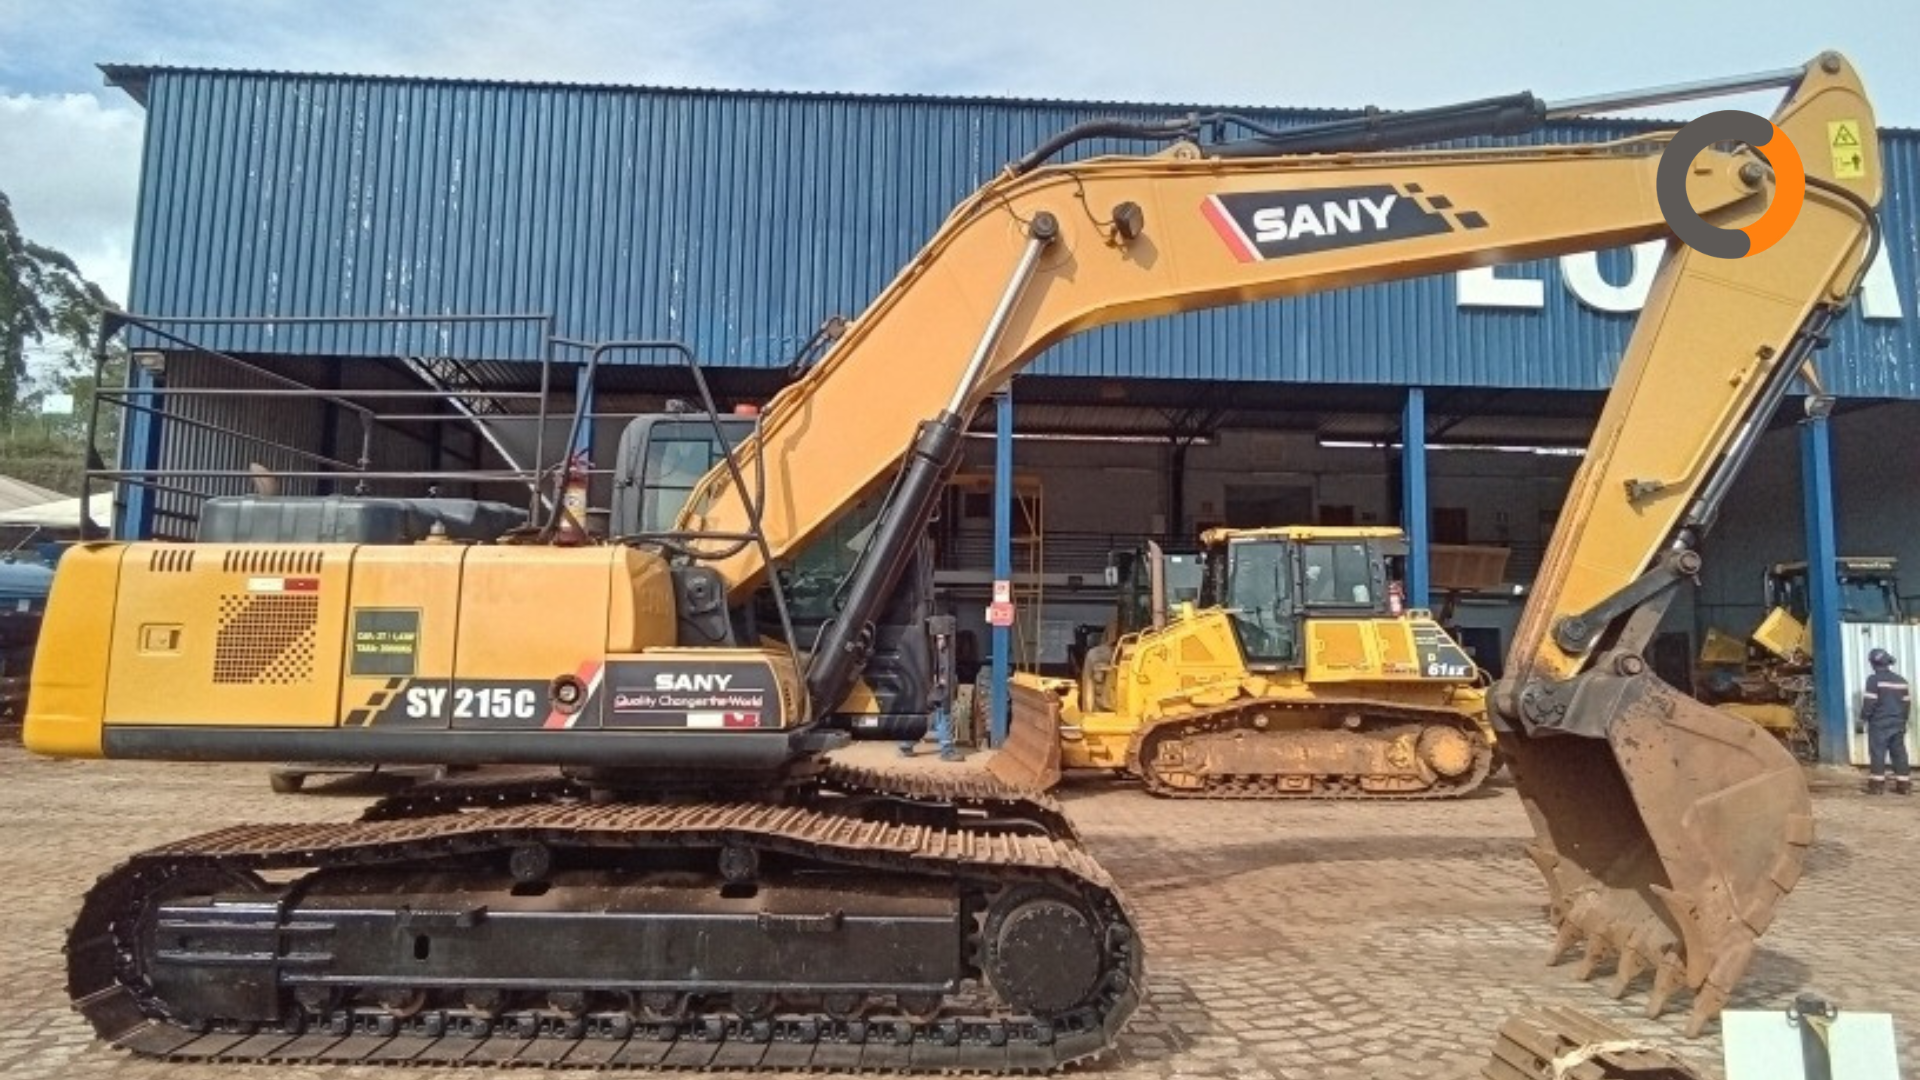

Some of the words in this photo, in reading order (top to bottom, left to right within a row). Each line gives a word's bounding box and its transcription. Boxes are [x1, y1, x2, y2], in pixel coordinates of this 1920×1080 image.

[1253, 195, 1397, 242] SANY
[655, 674, 732, 691] SANY
[406, 687, 447, 718] SY
[453, 687, 536, 718] 215C
[614, 694, 656, 708] Quality
[728, 695, 763, 706] World
